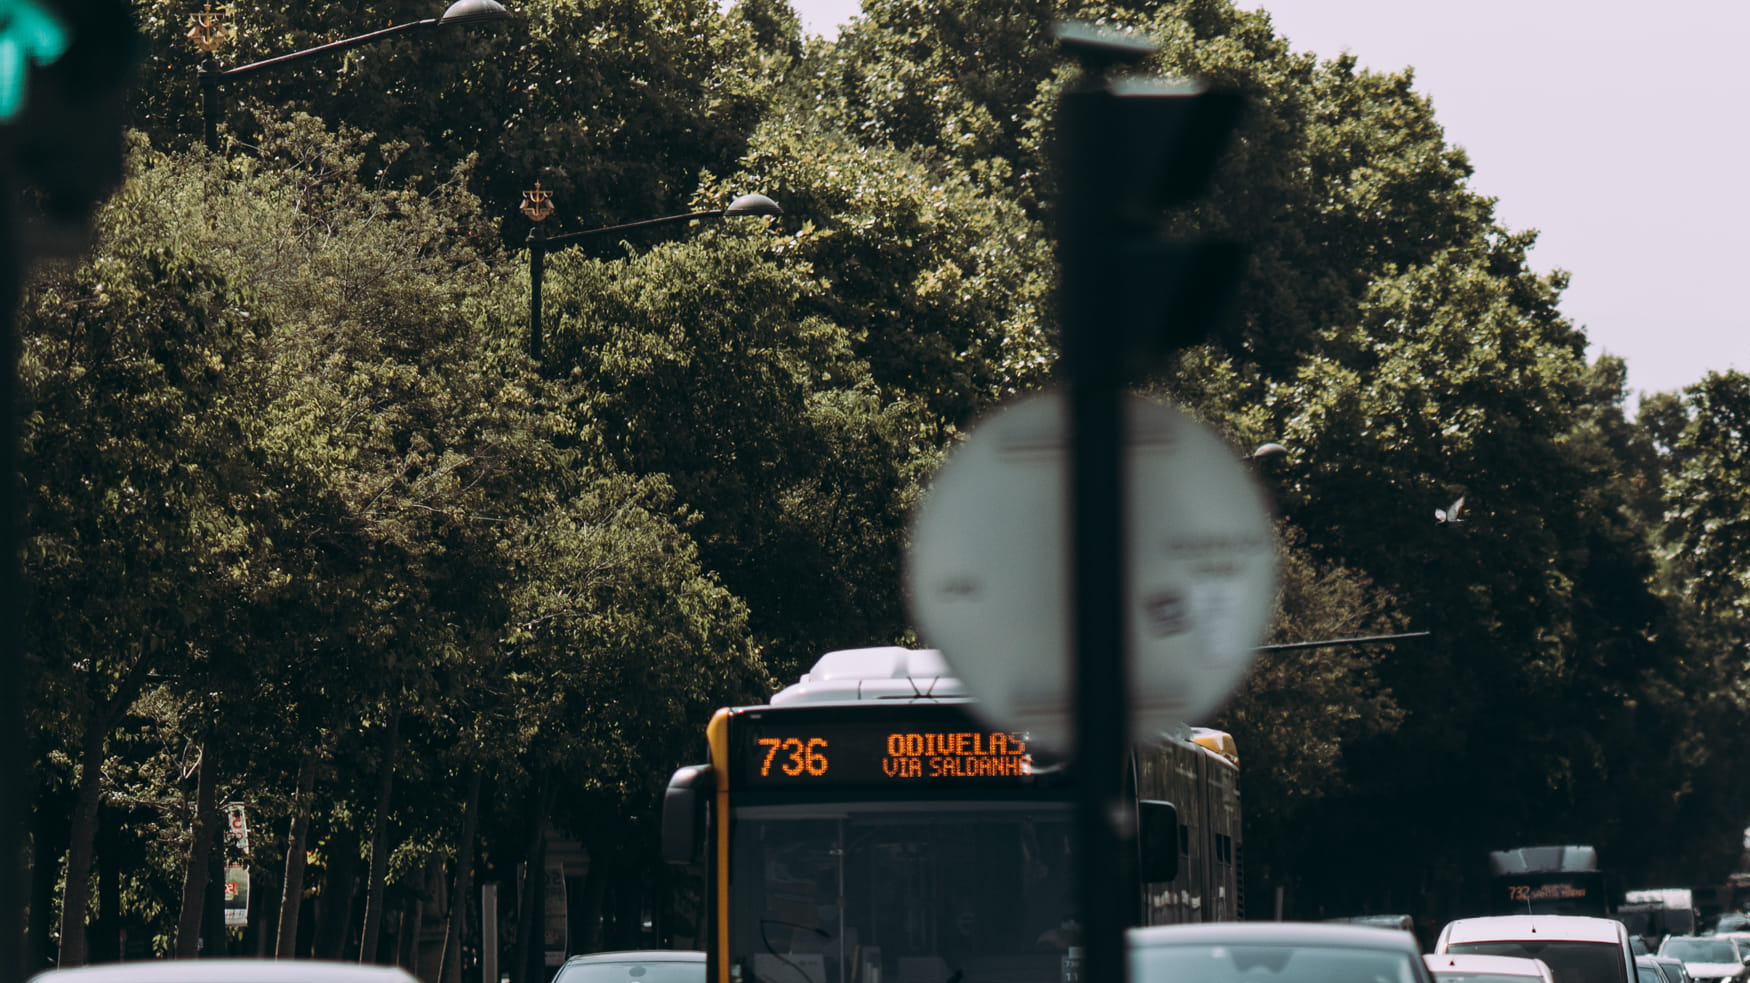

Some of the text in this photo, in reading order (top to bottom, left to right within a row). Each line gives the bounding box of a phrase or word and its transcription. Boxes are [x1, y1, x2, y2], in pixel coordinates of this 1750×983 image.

[887, 732, 1026, 756] ODIVELAS
[757, 737, 829, 777] 736
[882, 755, 1031, 777] VIA SALDANHA
